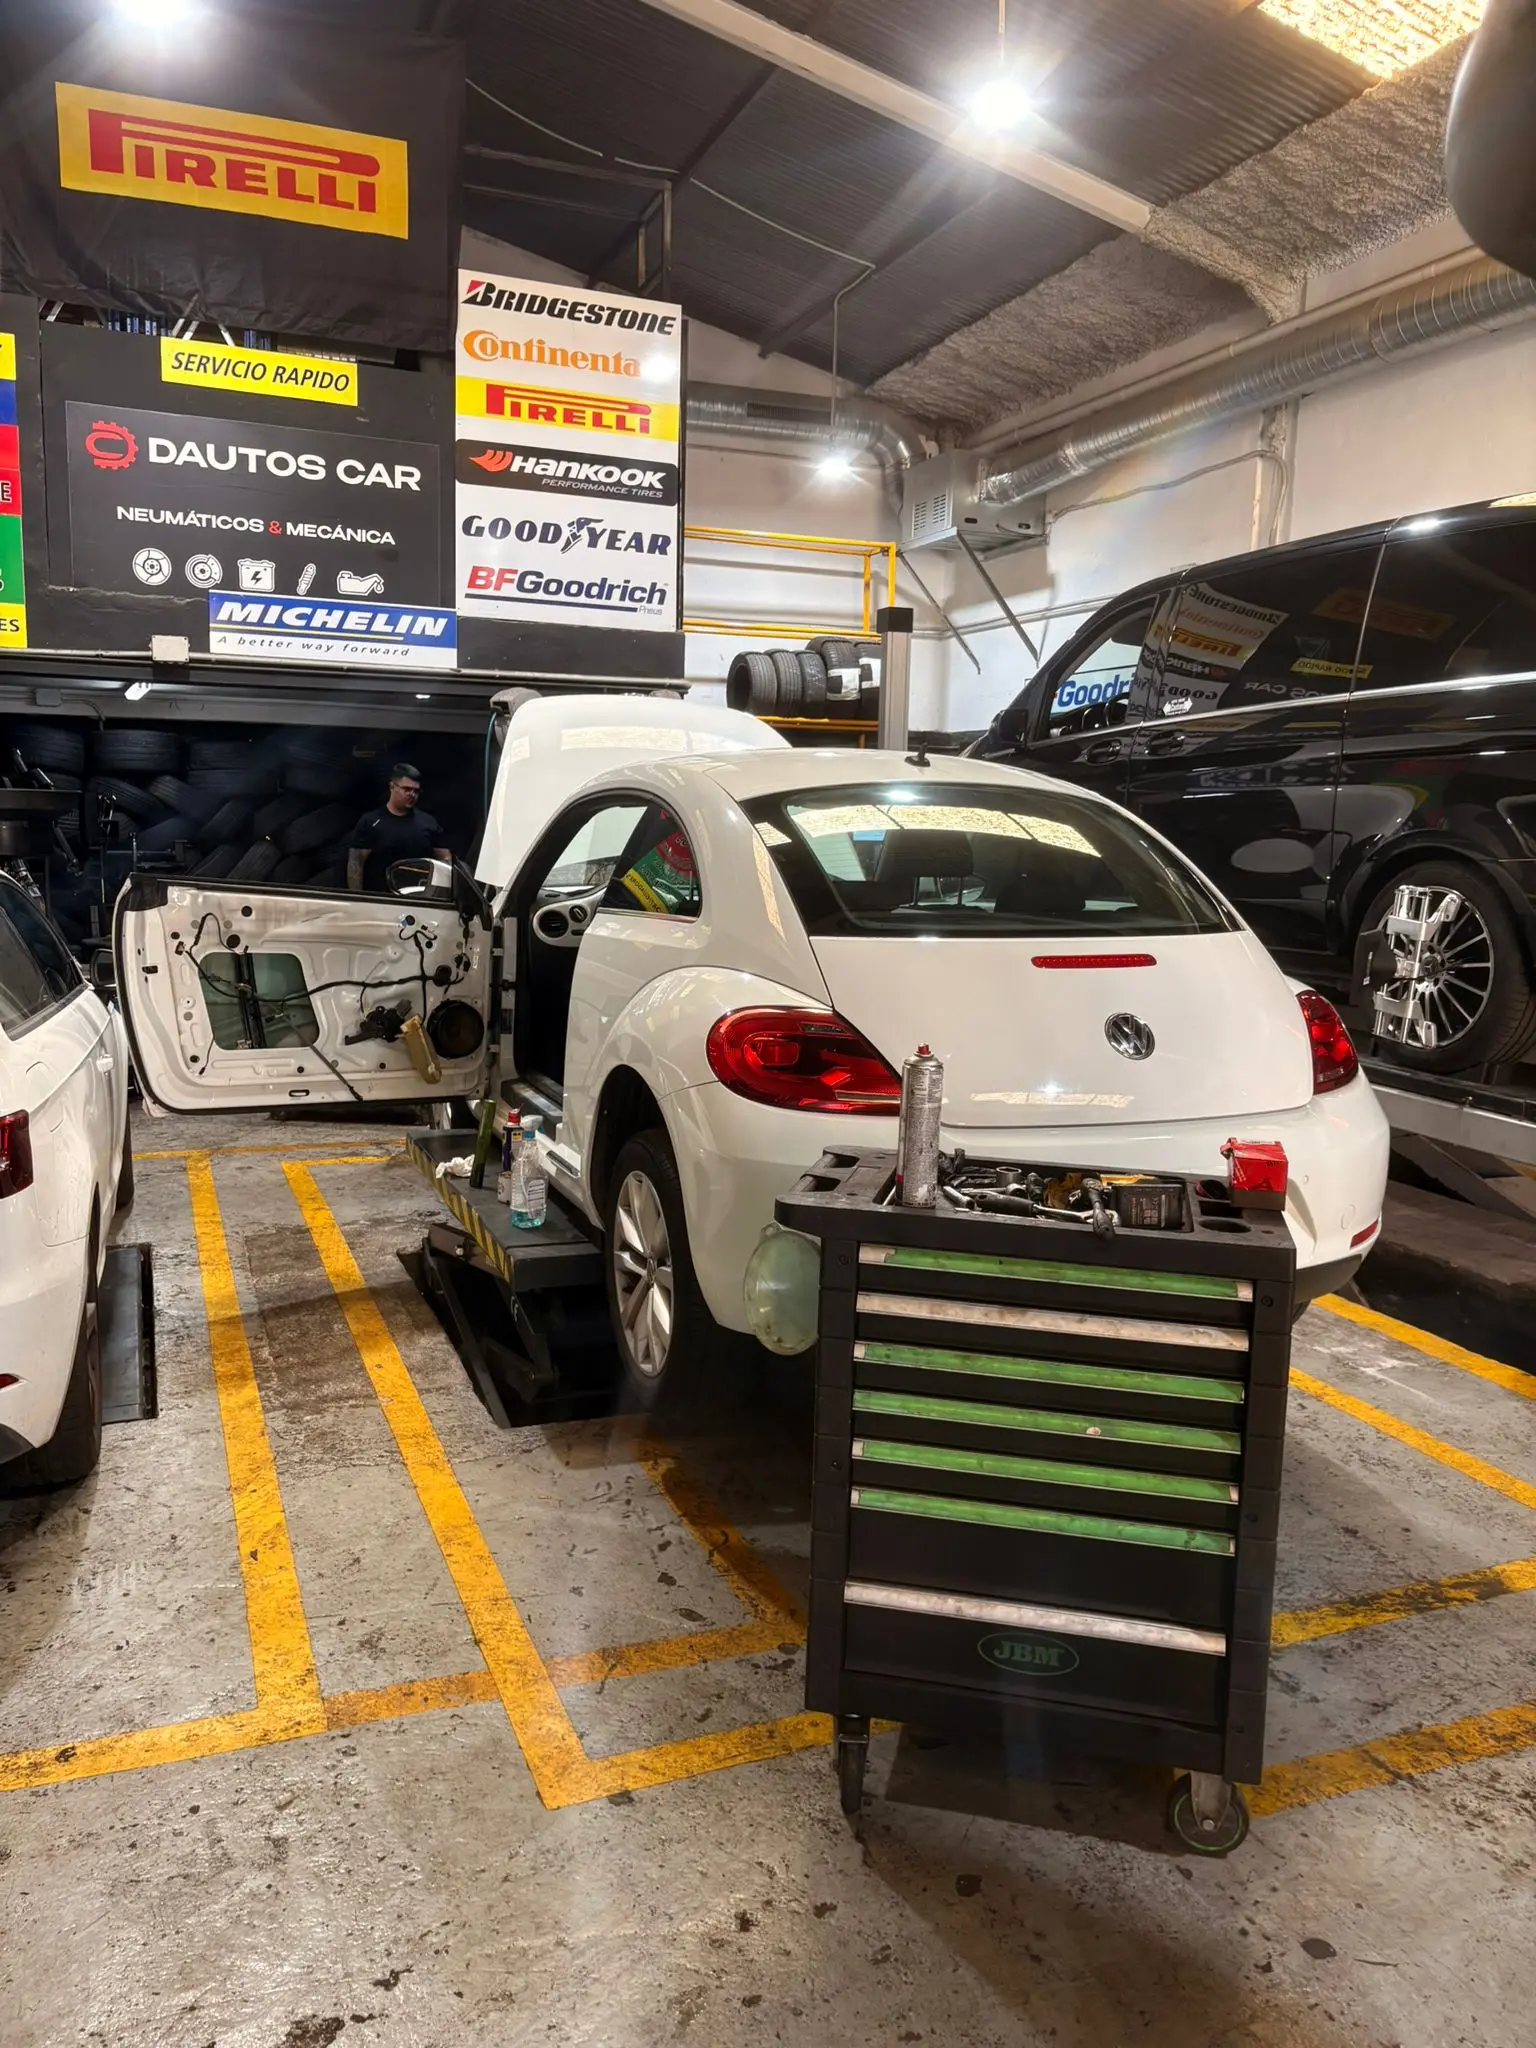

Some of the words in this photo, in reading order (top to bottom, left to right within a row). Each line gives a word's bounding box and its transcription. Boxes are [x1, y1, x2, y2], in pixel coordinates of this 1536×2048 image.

[88, 108, 380, 214] PIRELLI
[461, 279, 677, 335] BRIDGESTONE
[171, 351, 267, 381] SERVICIO
[272, 365, 350, 392] RAPIDO
[463, 330, 641, 378] Continenta
[485, 383, 652, 434] PIRELLI
[148, 436, 326, 481] DAUTOS
[336, 458, 422, 491] CAR
[541, 478, 629, 495] PERFORMANCE
[631, 488, 663, 498] TIRES
[116, 505, 265, 534] NEUMÁTICOS
[268, 520, 282, 535] &
[286, 521, 396, 546] MECÁNICA
[467, 565, 667, 606] BFGoodrich
[217, 601, 448, 638] MICHELIN
[217, 635, 228, 644] A
[238, 637, 293, 650] better
[301, 643, 334, 653] way
[342, 643, 410, 657] forward
[993, 1640, 1065, 1666] JBM
